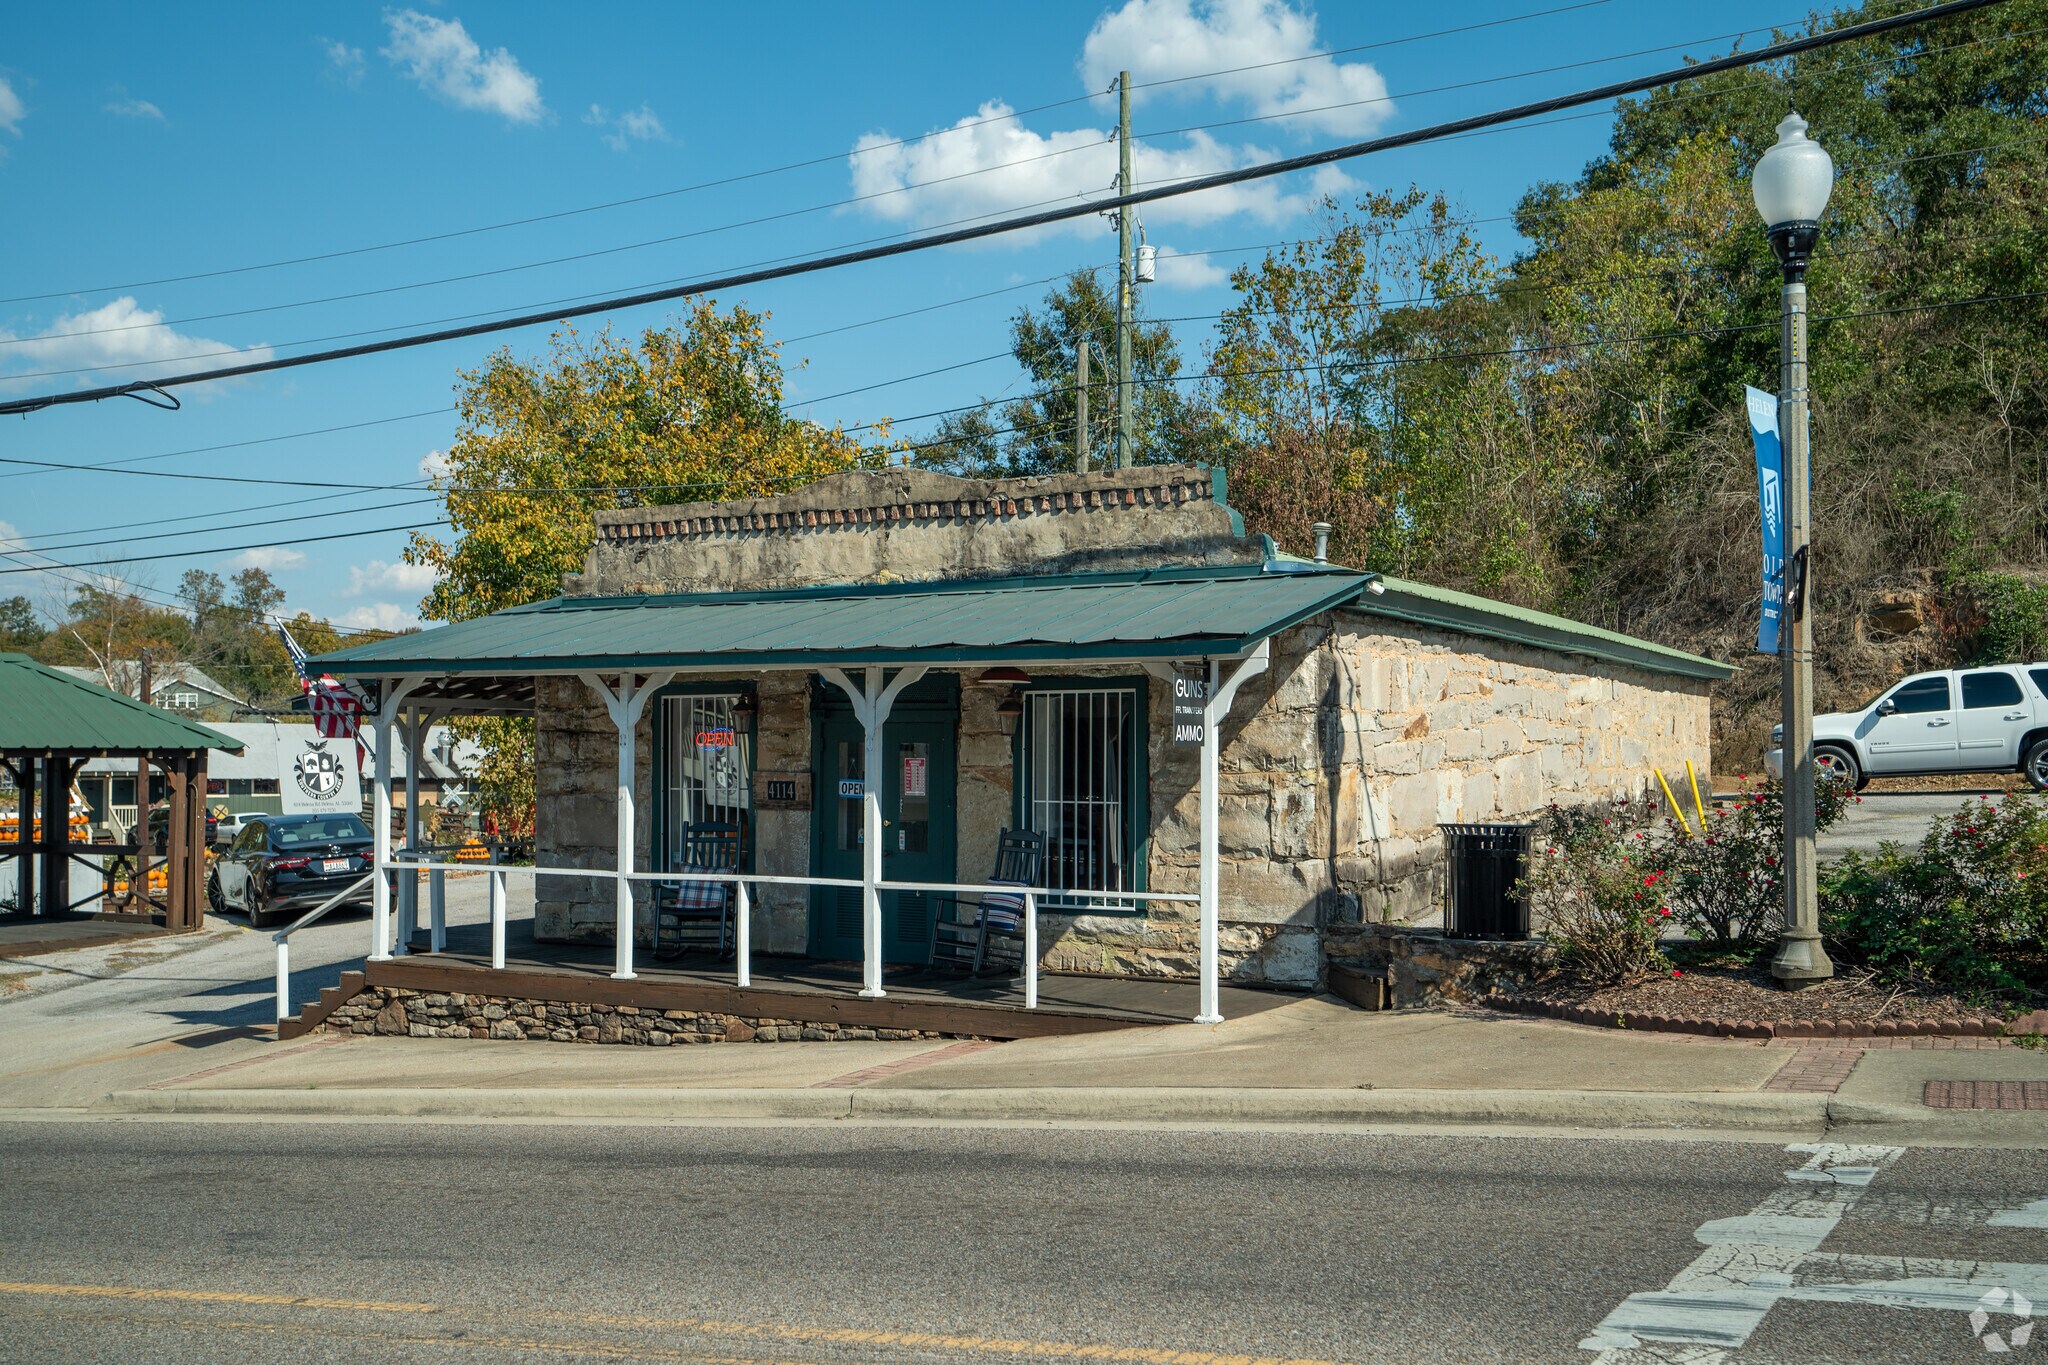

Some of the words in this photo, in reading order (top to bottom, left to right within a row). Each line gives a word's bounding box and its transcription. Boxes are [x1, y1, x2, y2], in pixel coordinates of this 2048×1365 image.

[1763, 553, 1784, 578] OLD
[1763, 580, 1783, 604] TOWN
[1175, 678, 1203, 698] GUNS
[695, 731, 734, 746] OPEN
[1175, 724, 1203, 741] AMMO
[768, 782, 794, 799] 4114
[841, 782, 865, 795] OPEN
